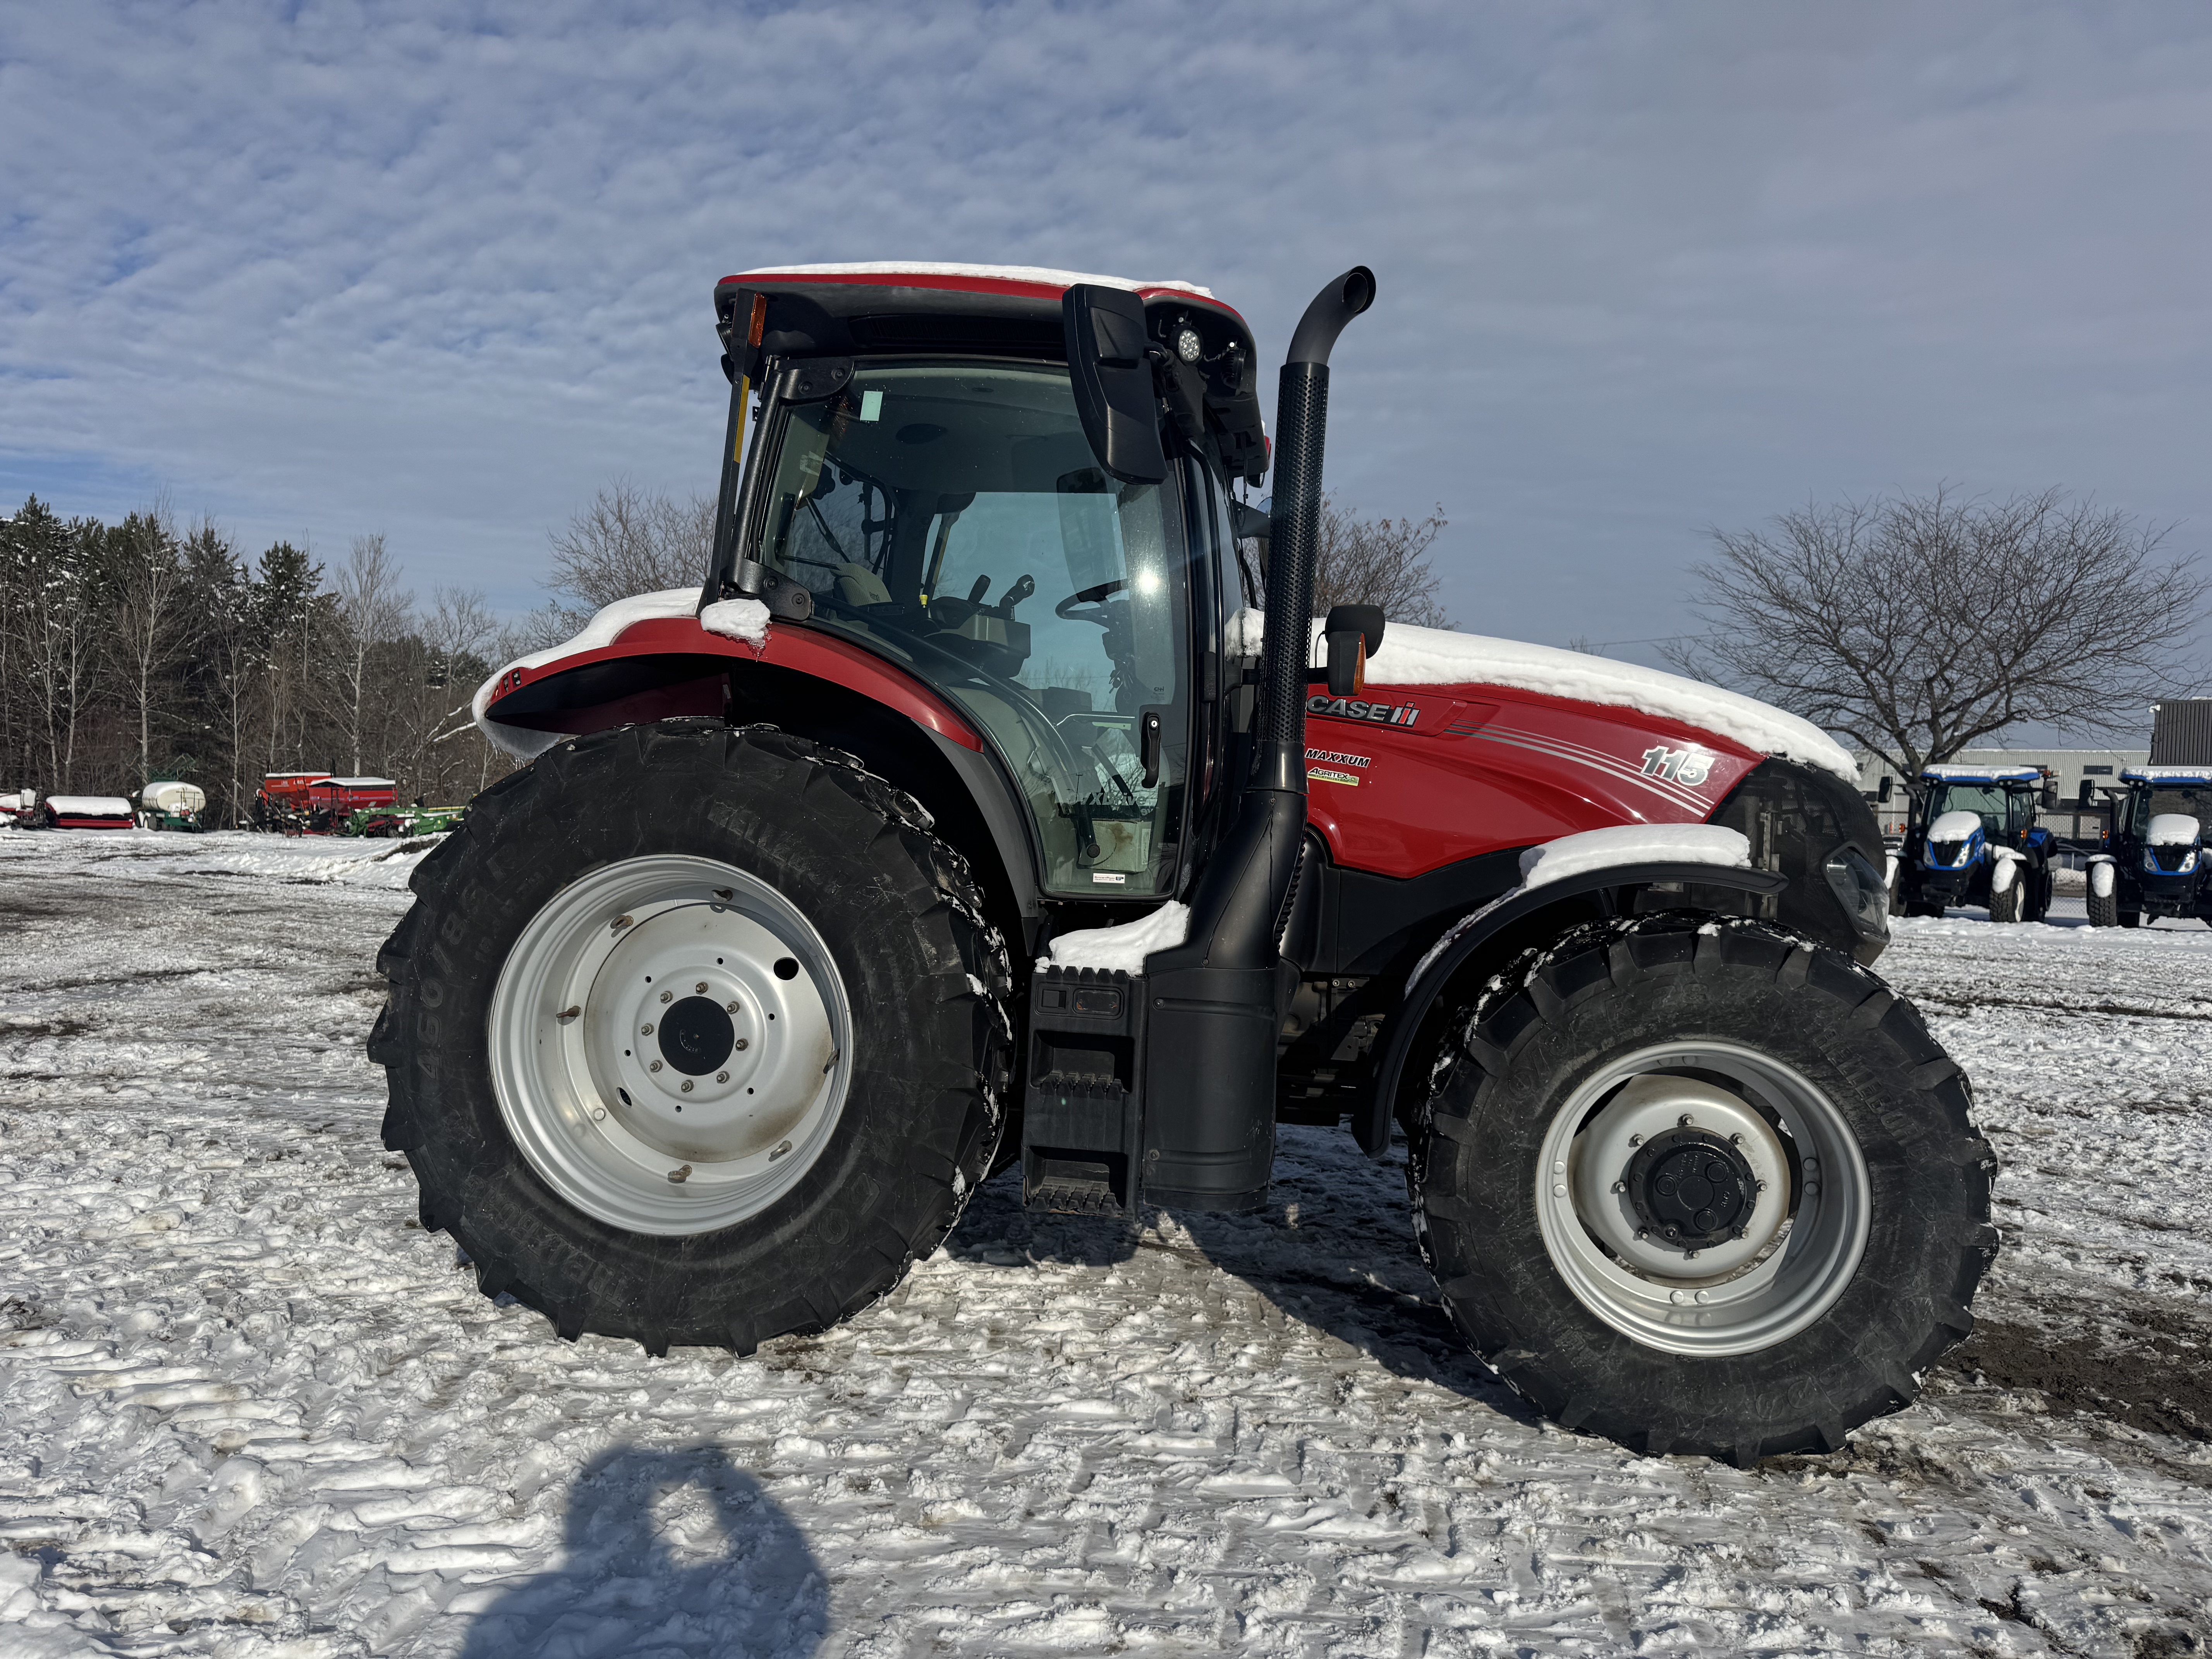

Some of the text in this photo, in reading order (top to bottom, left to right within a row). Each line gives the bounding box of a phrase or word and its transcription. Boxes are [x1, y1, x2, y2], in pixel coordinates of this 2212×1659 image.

[1307, 696, 1390, 721] CASE
[1305, 749, 1371, 768] MAXXUM
[1640, 745, 1716, 786] 115
[1310, 768, 1348, 780] AGRITEX
